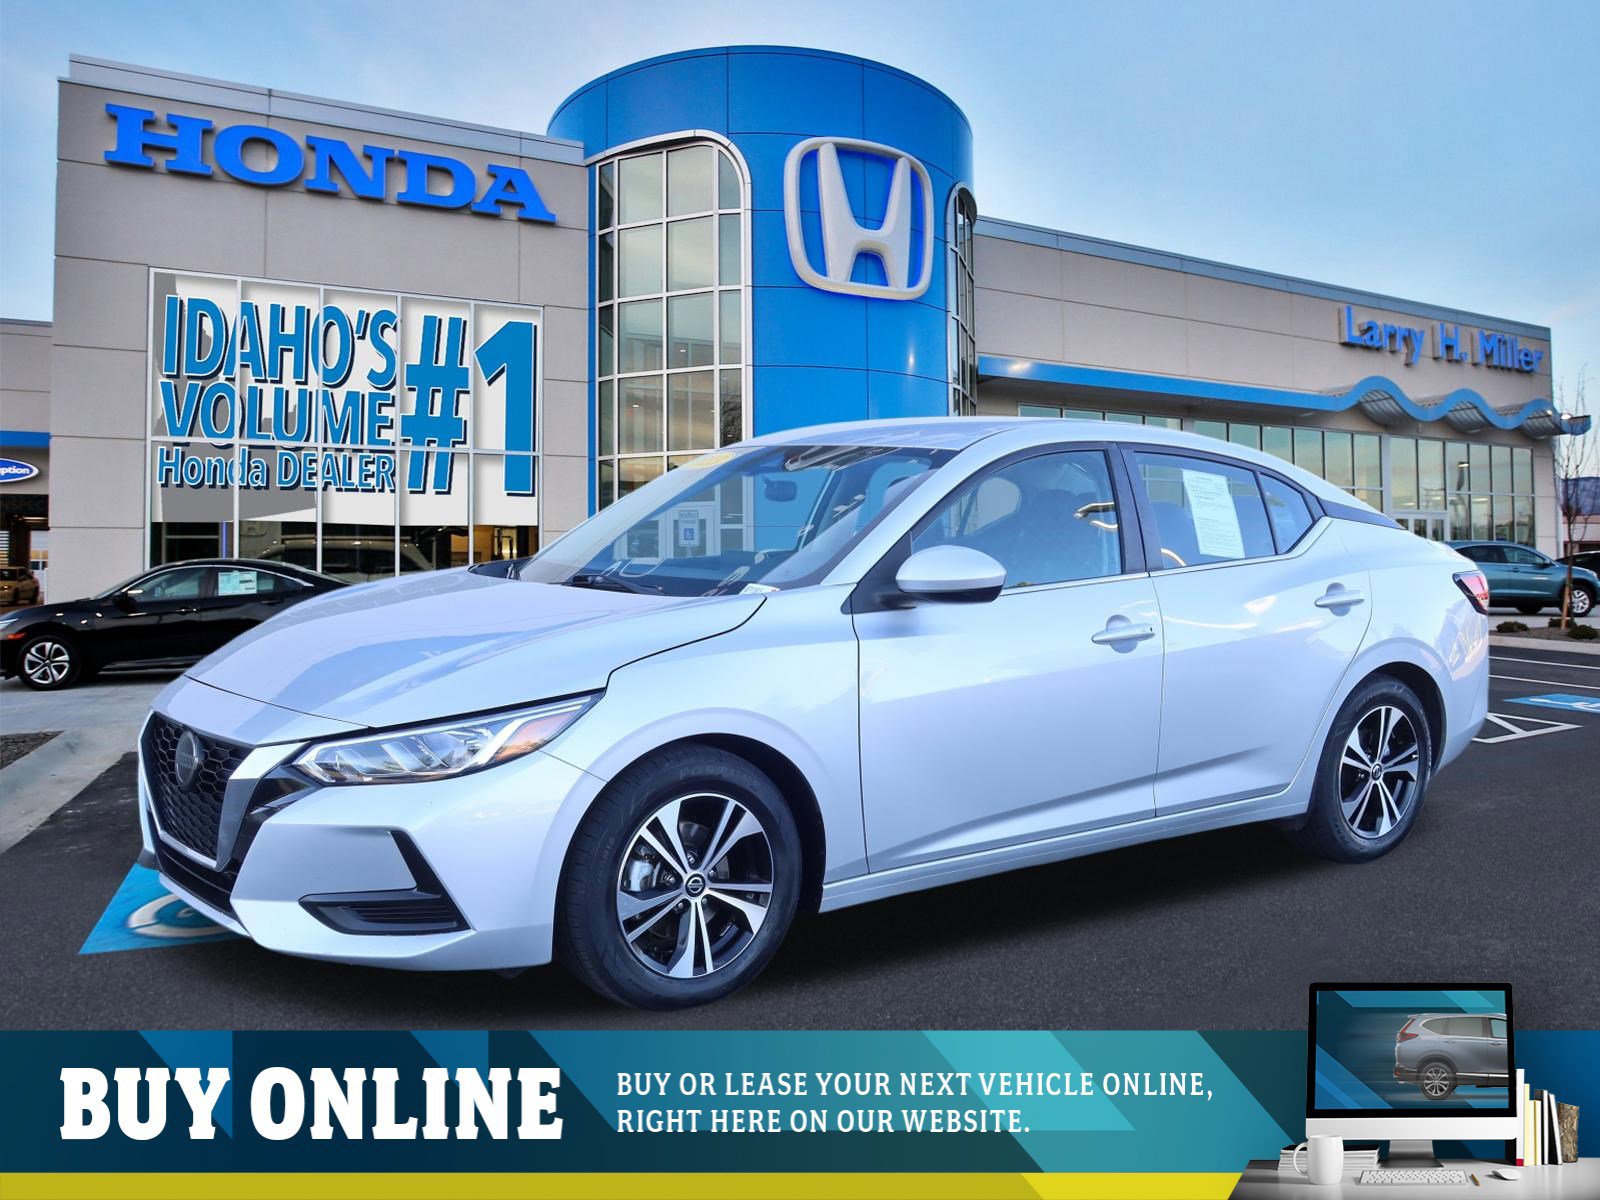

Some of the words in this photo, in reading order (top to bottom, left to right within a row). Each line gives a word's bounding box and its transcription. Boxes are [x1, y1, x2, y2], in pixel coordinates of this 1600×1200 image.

[104, 103, 557, 223] HONDA
[162, 295, 397, 389] IDAHO'S
[1341, 305, 1424, 366] Larry
[1436, 323, 1468, 362] H.
[1474, 330, 1544, 372] Miller
[160, 380, 395, 450] VOLUME
[400, 314, 537, 494] #1
[0, 465, 30, 476] ption
[156, 446, 268, 488] Honda
[276, 450, 396, 491] DEALER
